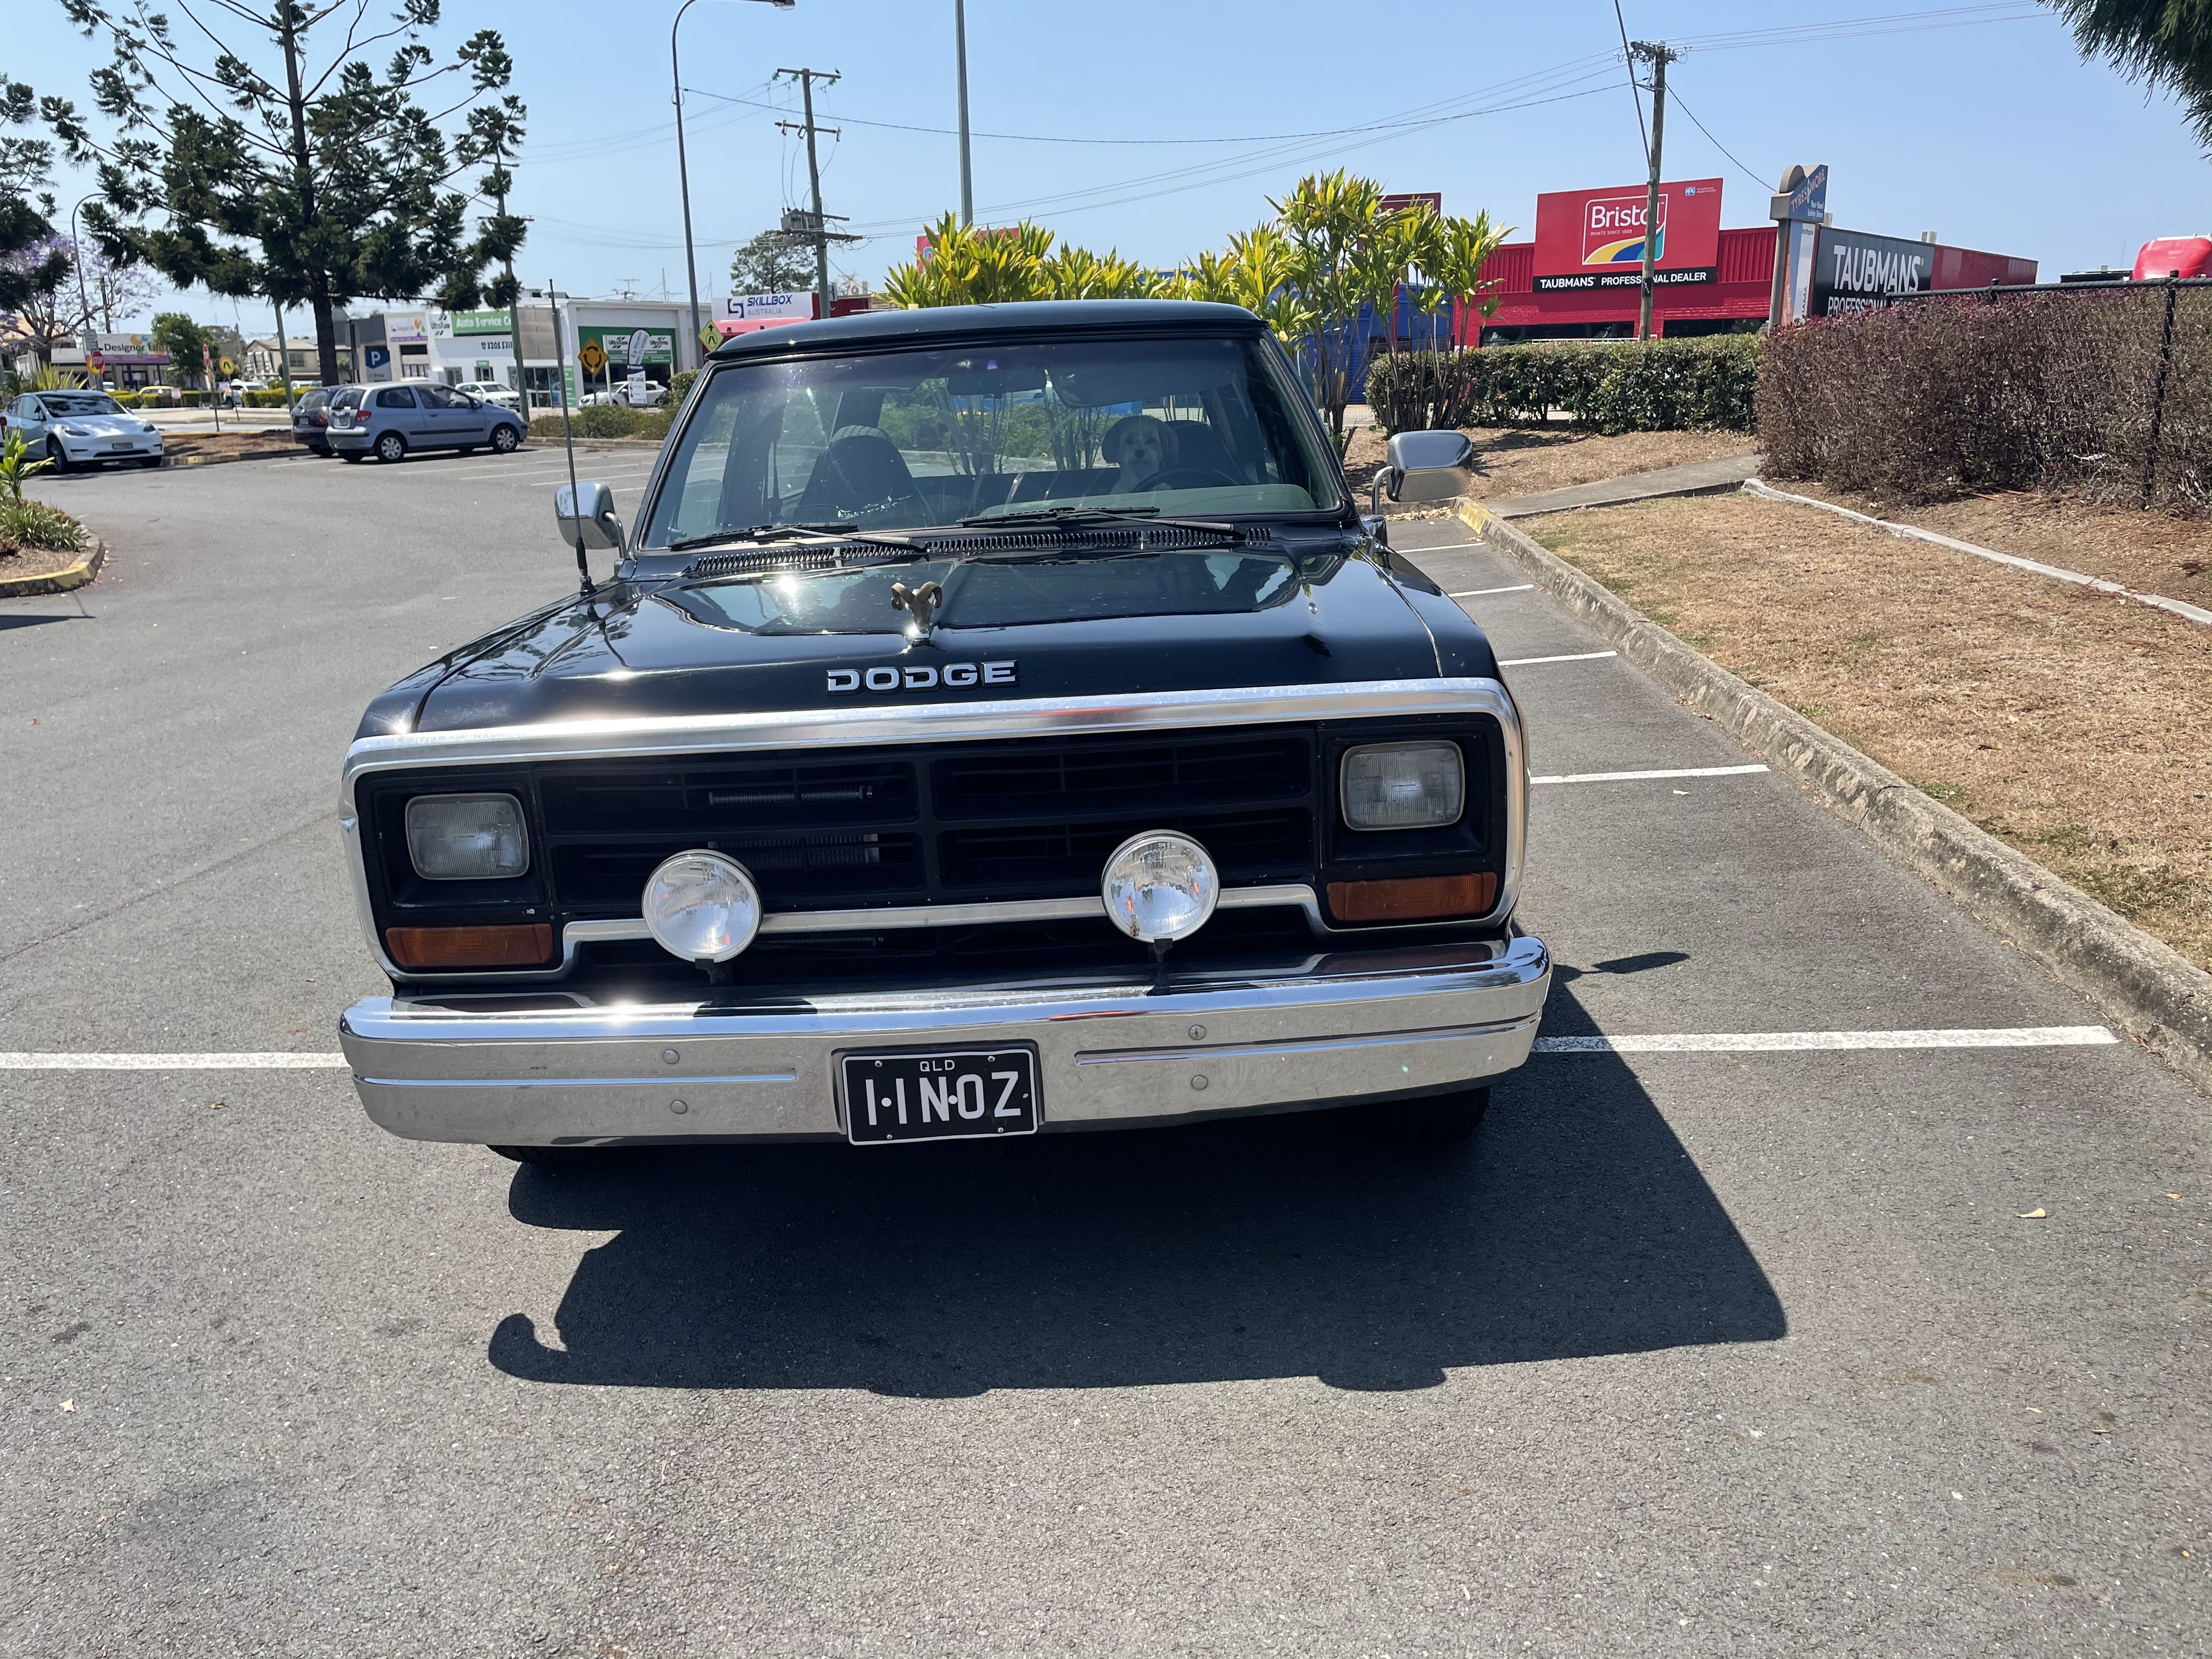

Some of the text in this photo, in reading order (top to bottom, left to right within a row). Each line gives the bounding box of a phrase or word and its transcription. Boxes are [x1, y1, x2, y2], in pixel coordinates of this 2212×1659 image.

[1791, 187, 1809, 212] TYRES
[1810, 168, 1826, 194] MORE
[1833, 245, 1920, 294] TAUBMANS
[1540, 272, 1707, 289] TAUBMANS PROFESSNAL DEALER
[747, 295, 793, 307] SKILLBOX
[748, 308, 783, 316] AUSTRALIA
[456, 318, 475, 328] Auto
[475, 315, 503, 328] Service
[104, 343, 145, 353] Designer
[93, 356, 103, 365] STOP
[371, 351, 381, 366] P
[826, 659, 1018, 695] DODGE
[920, 1059, 955, 1072] QLD
